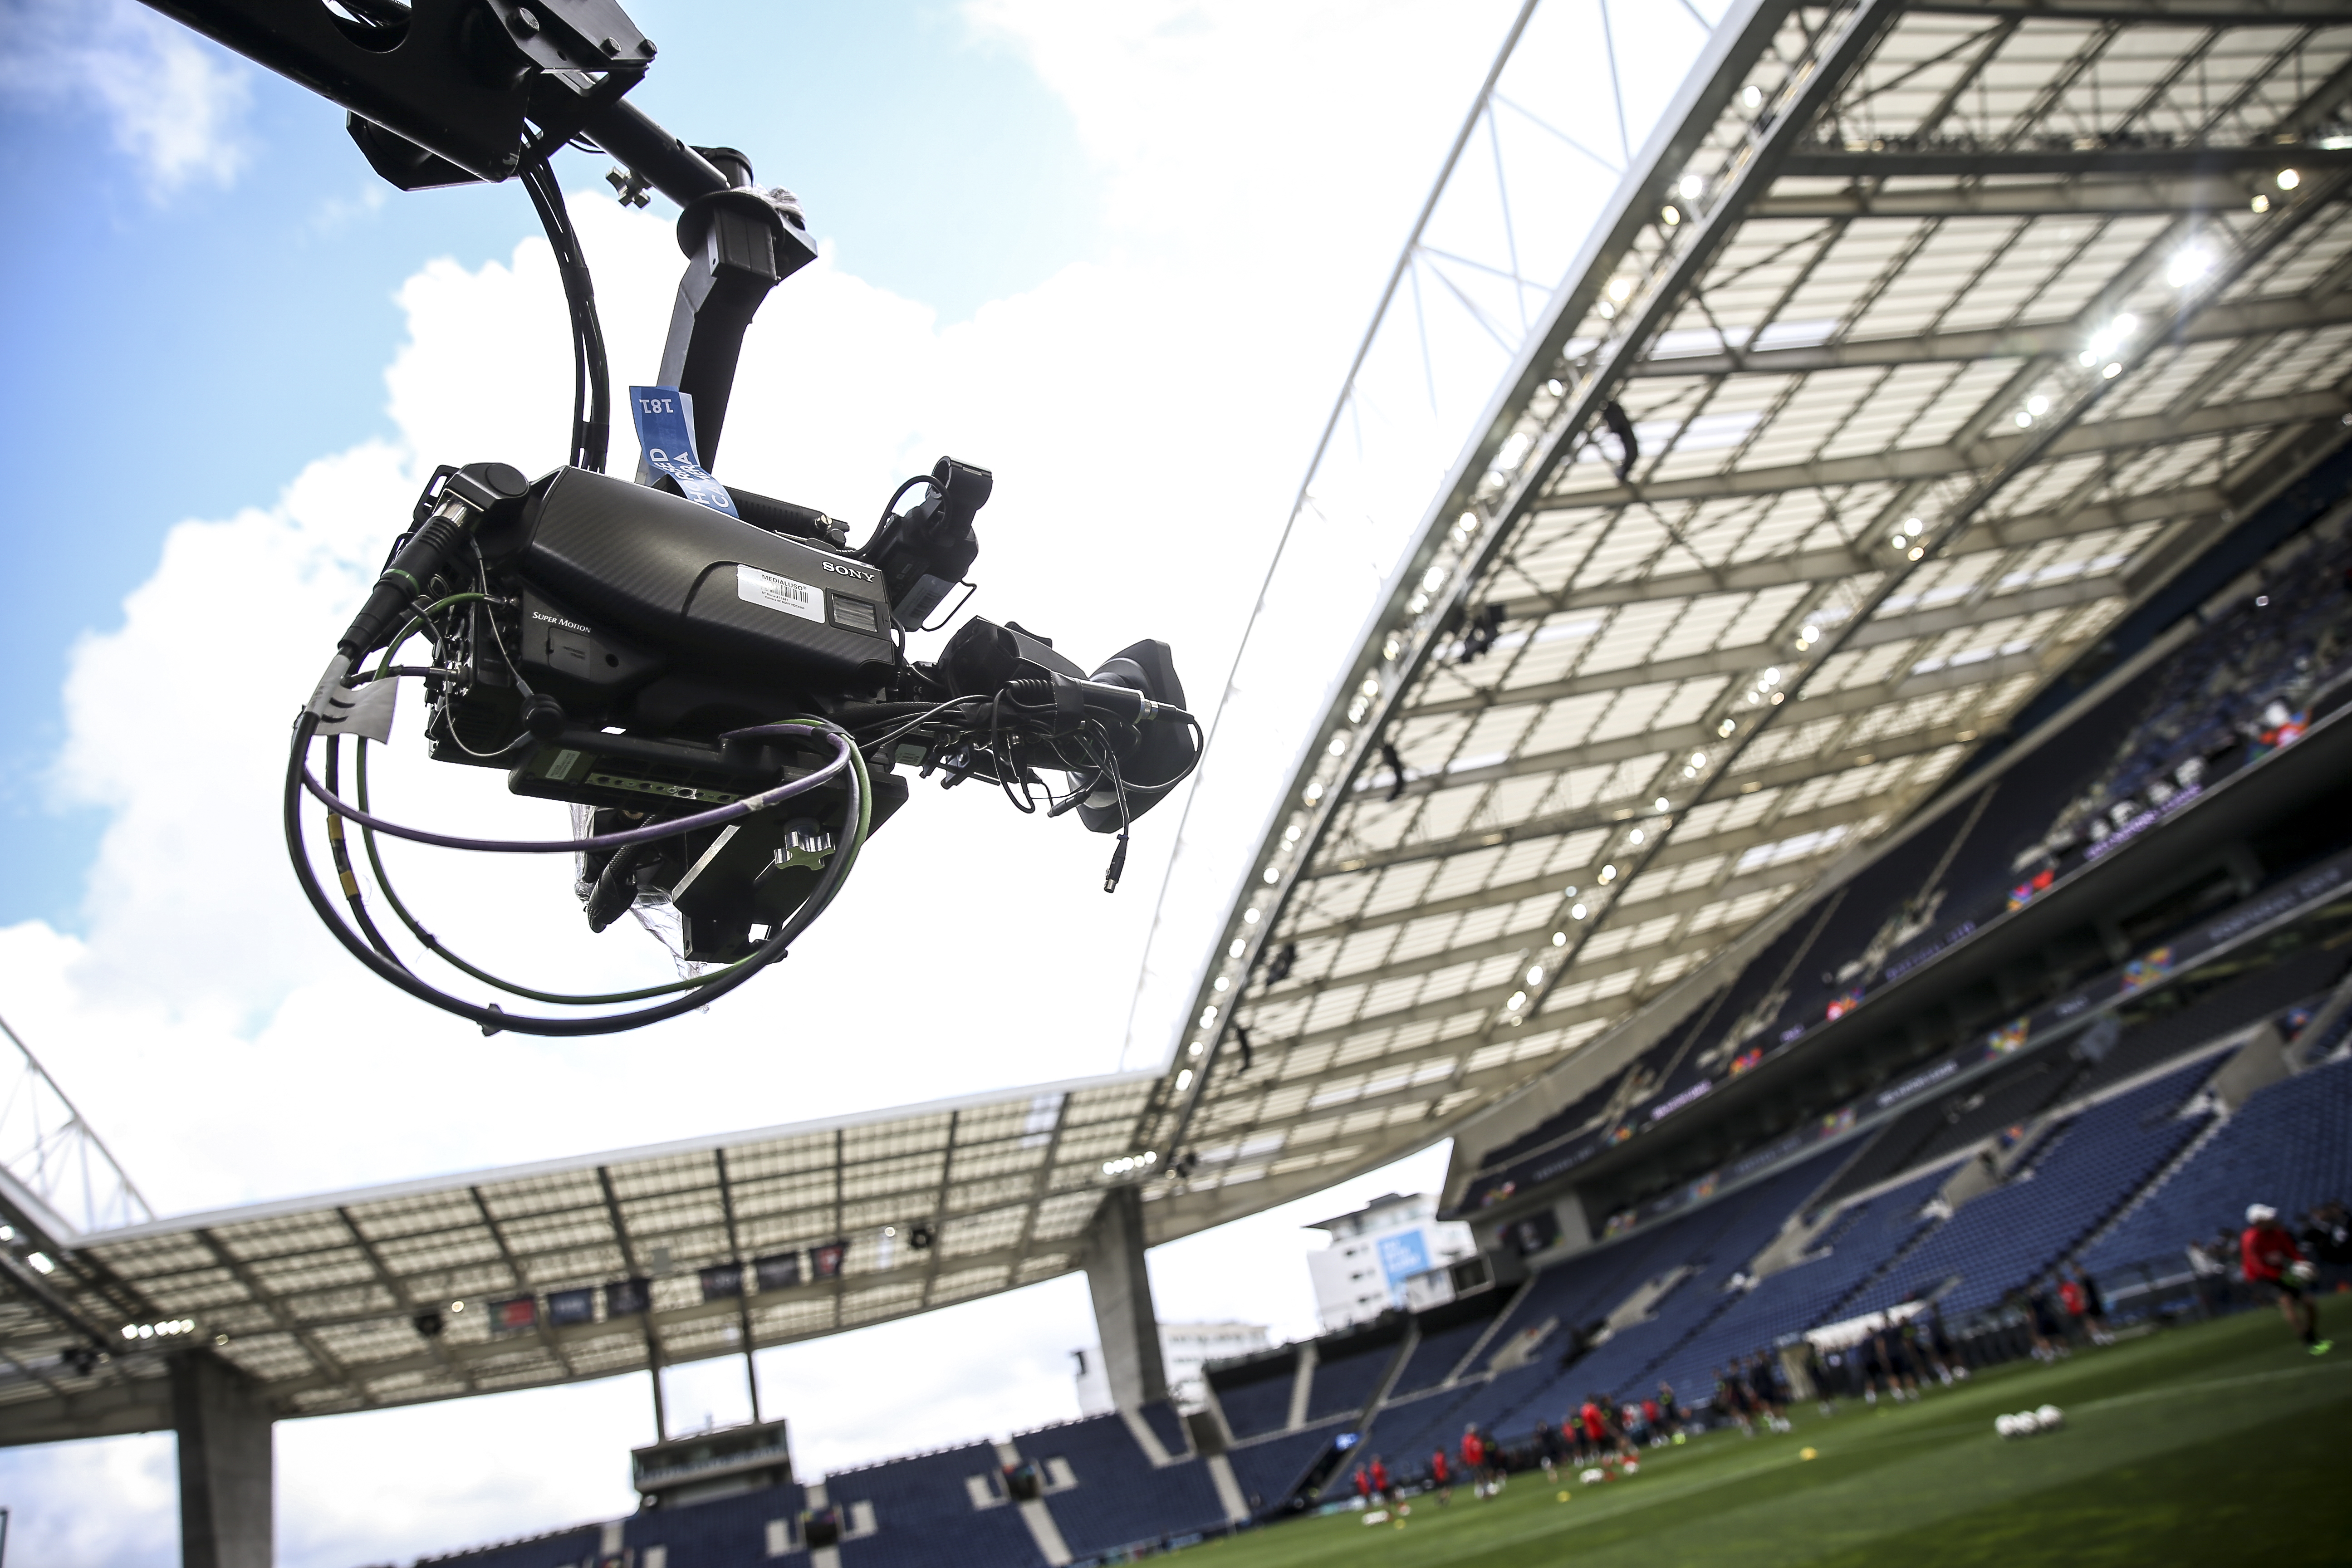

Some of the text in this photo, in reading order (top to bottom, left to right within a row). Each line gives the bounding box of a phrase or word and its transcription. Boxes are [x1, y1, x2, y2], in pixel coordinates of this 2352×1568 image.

[639, 399, 674, 414] 181
[649, 448, 711, 505] HORISED
[673, 451, 730, 508] CAMERA
[822, 561, 875, 583] SONY
